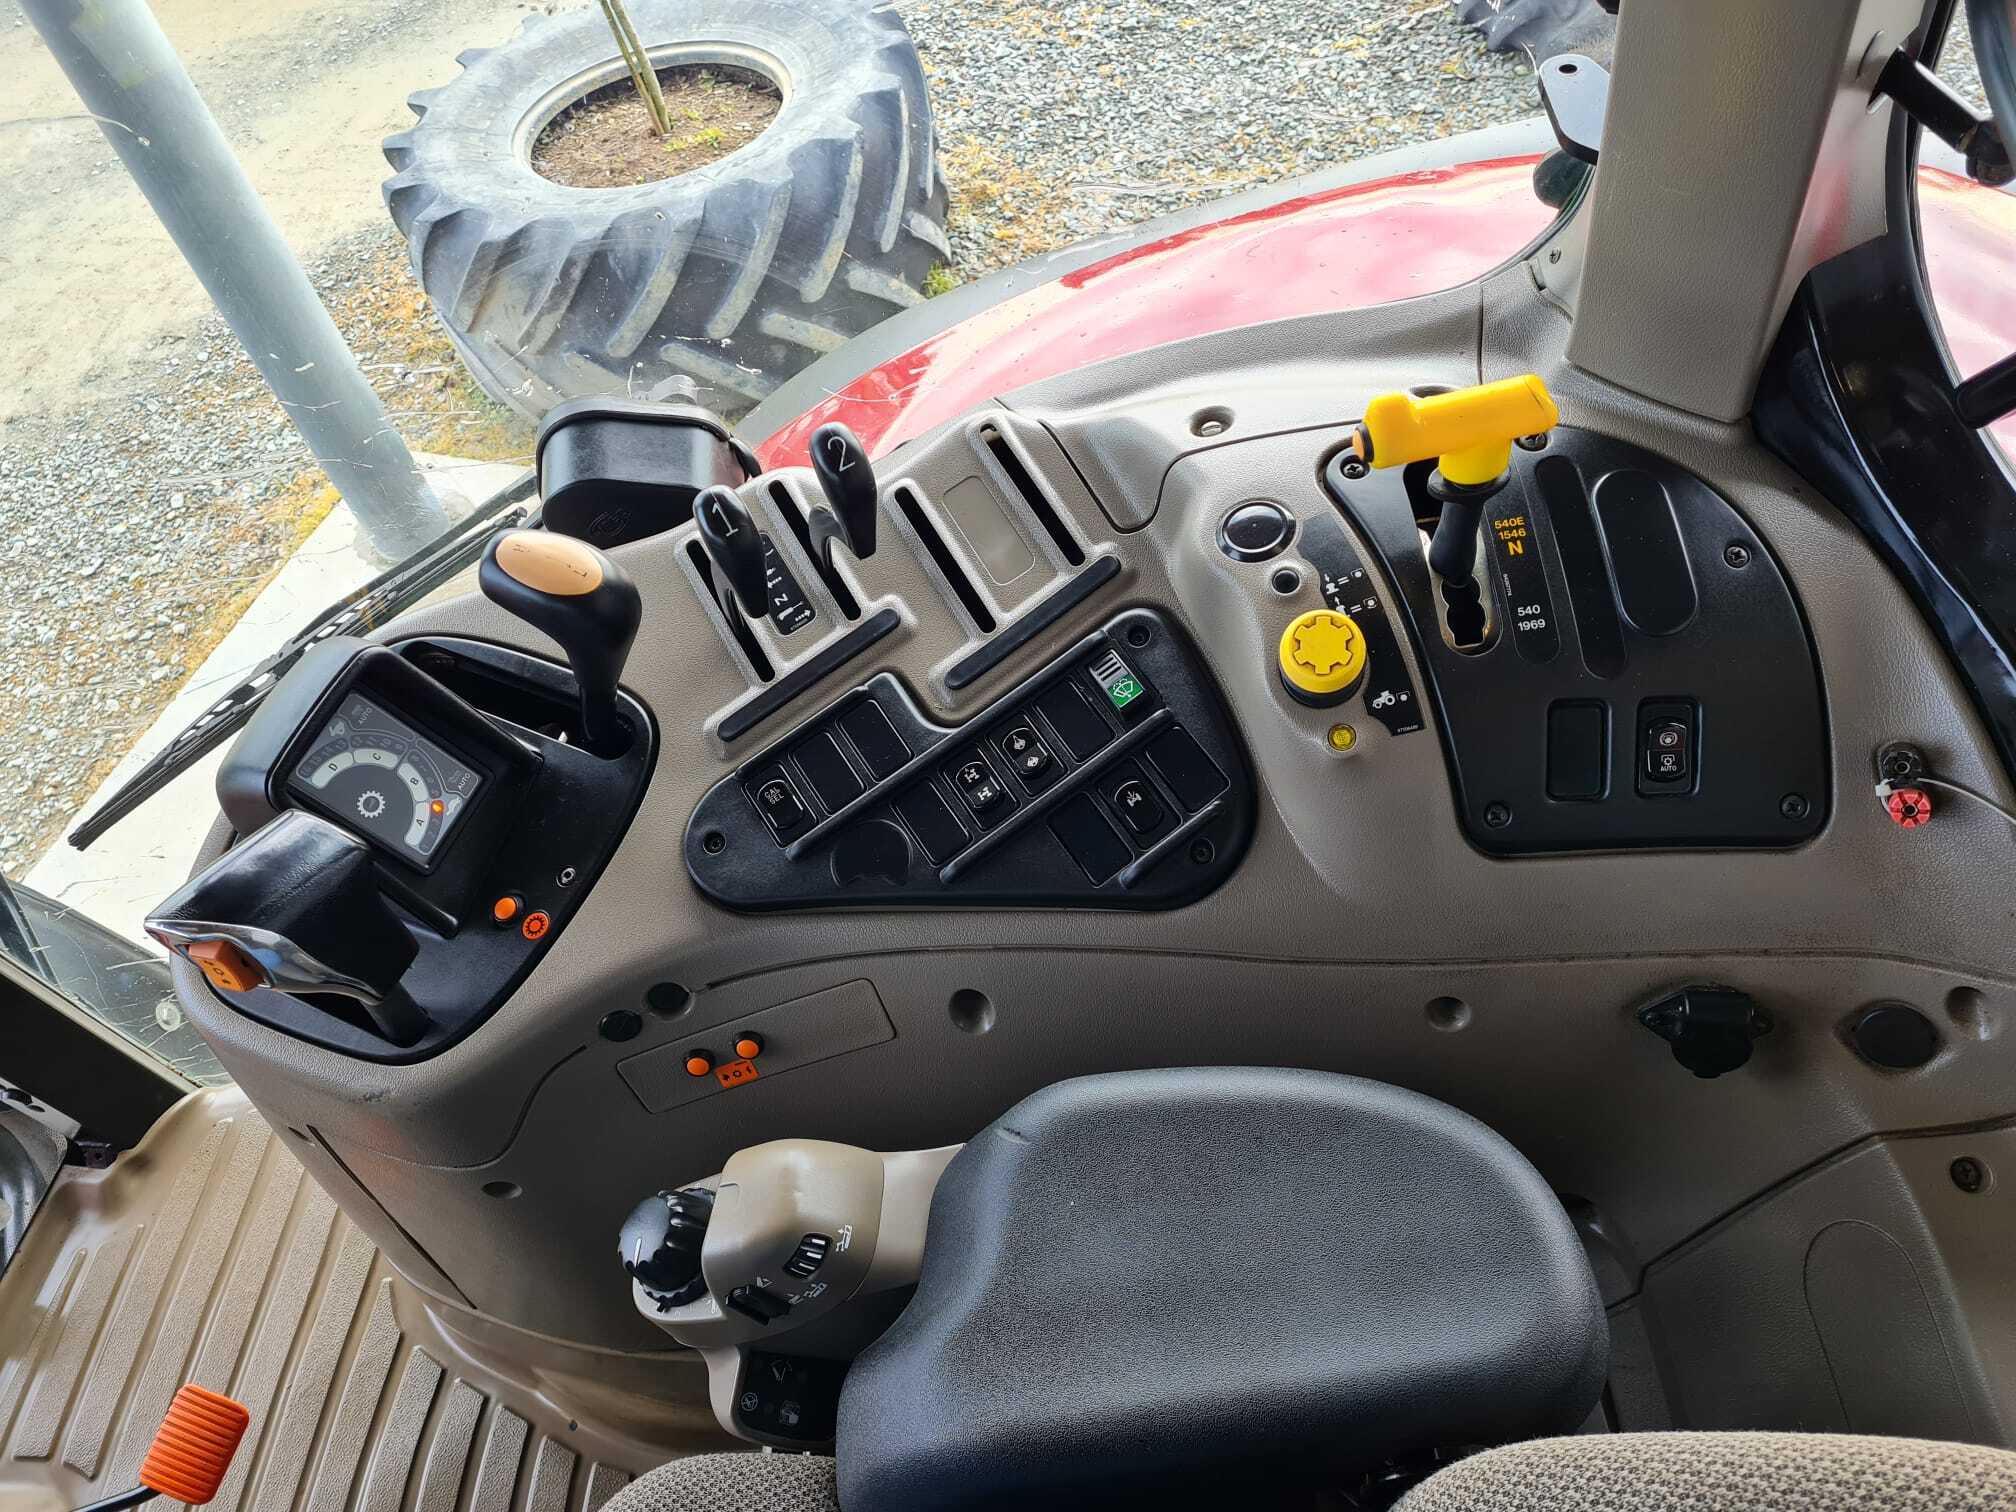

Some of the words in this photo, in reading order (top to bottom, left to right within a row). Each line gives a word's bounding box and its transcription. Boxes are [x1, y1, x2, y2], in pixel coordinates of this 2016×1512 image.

[827, 437, 855, 472] 2
[711, 503, 739, 537] 1
[1494, 516, 1525, 529] 540E
[1498, 528, 1526, 540] 1546
[1508, 540, 1524, 555] N
[1517, 604, 1540, 617] 540
[1517, 619, 1546, 632] 1969
[358, 707, 373, 725] AUTO
[372, 753, 382, 761] C
[328, 762, 338, 771] D
[410, 777, 419, 785] B
[458, 772, 471, 790] AUTO
[415, 818, 424, 826] A
